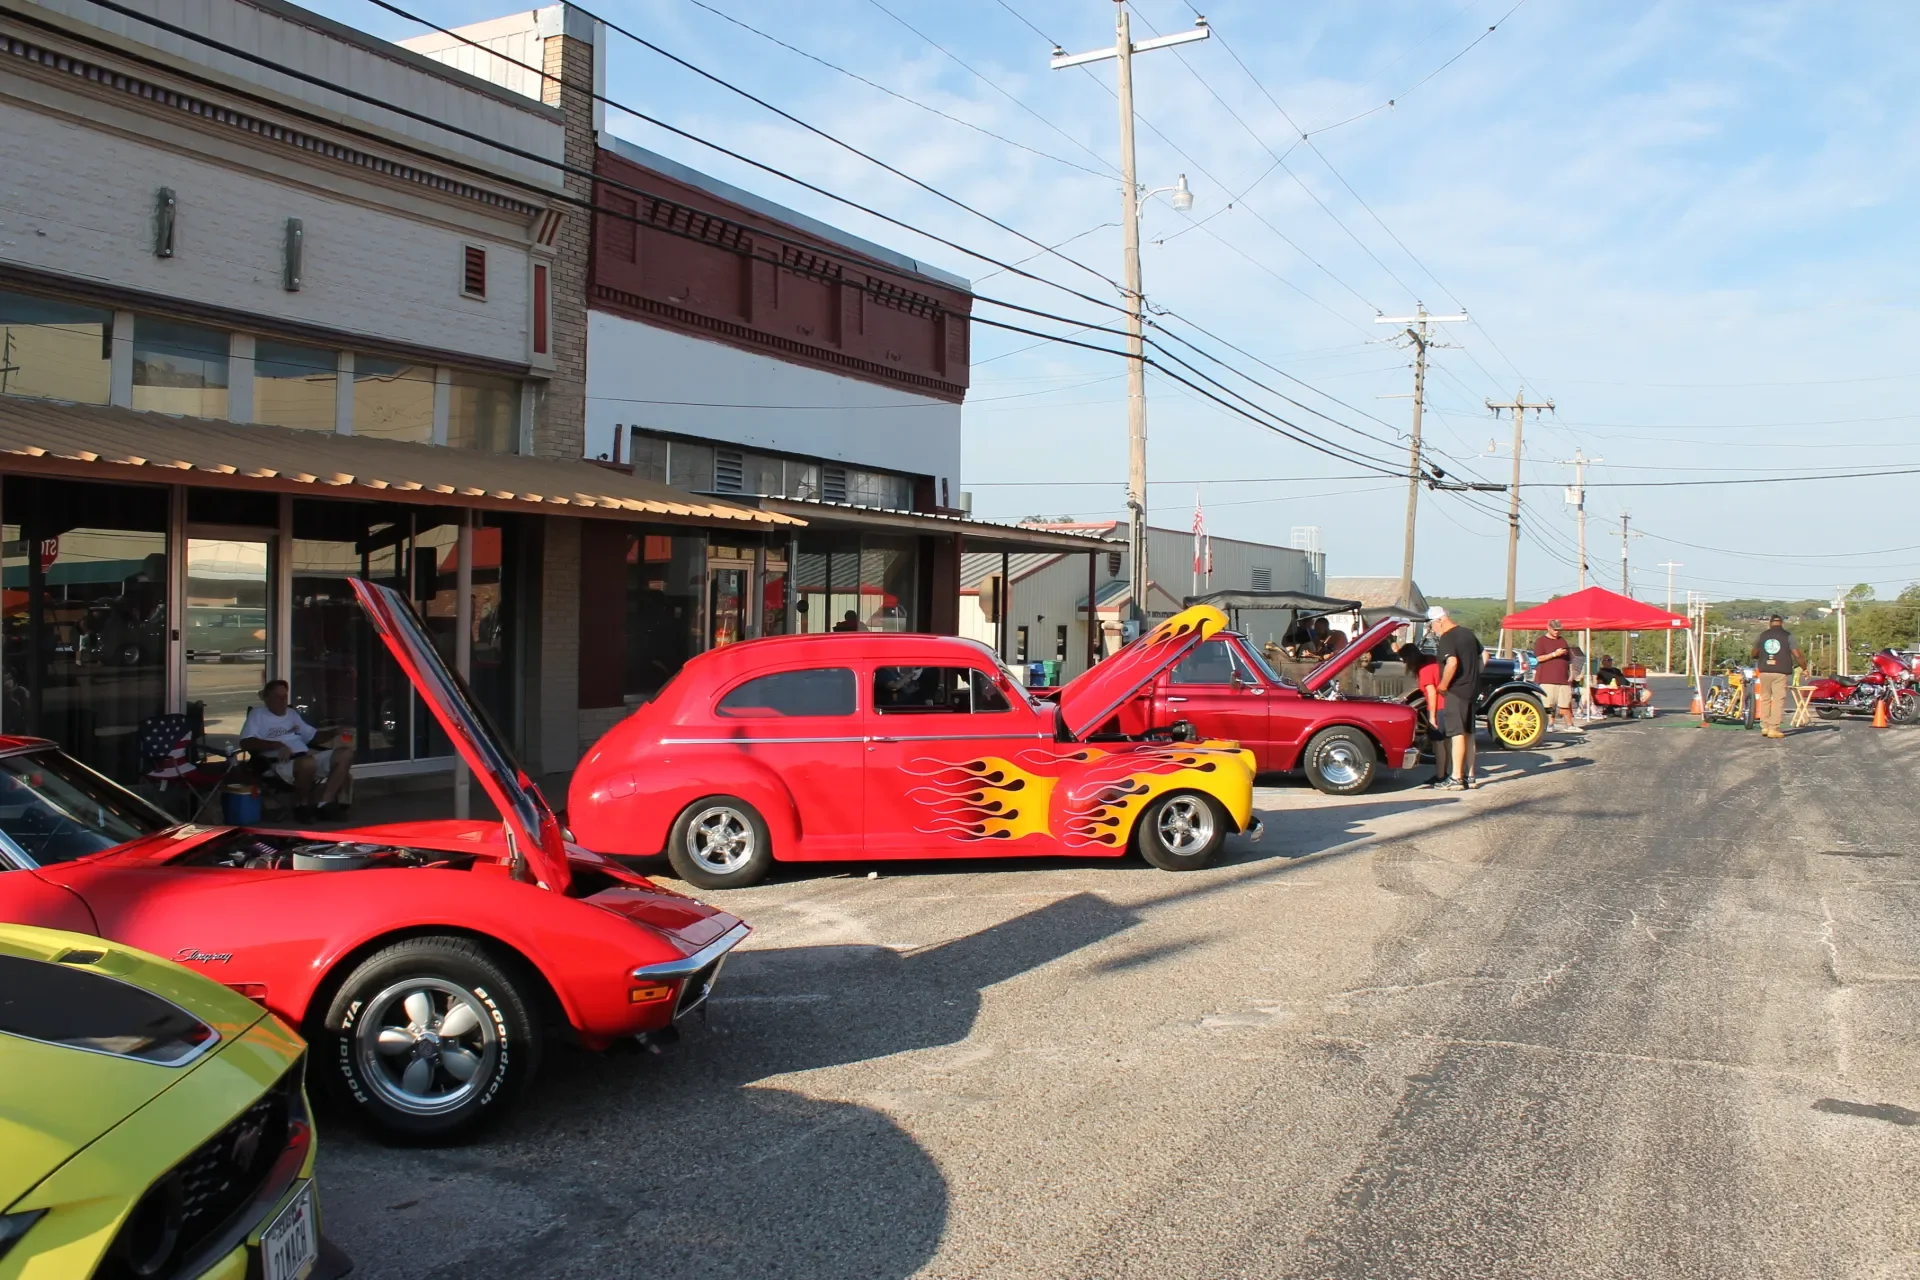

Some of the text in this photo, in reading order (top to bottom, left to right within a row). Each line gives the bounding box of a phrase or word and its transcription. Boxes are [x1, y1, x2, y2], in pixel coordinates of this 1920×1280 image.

[170, 947, 233, 964] Stingray
[340, 1000, 368, 1103] Radial T/A
[474, 987, 508, 1105] BFGoodrich
